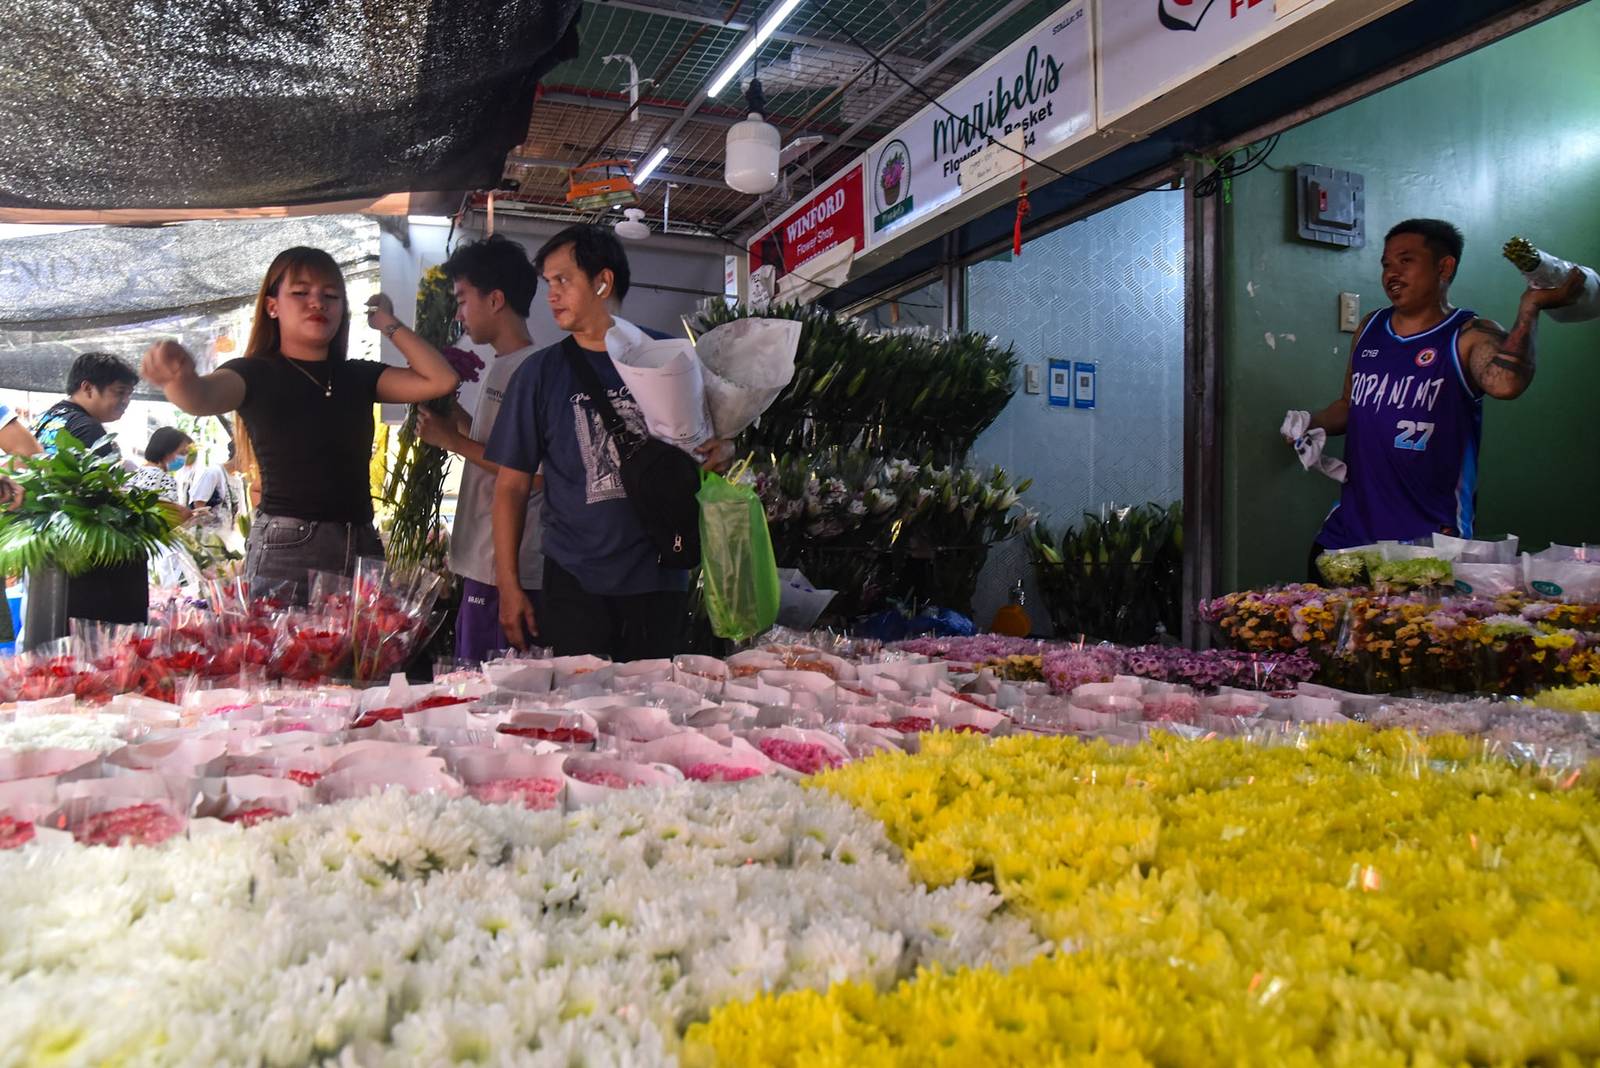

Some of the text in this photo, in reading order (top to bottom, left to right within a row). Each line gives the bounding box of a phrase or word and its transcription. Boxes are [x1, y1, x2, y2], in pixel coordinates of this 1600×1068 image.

[786, 188, 846, 244] WINFORD
[817, 226, 835, 244] Shop
[1412, 377, 1445, 412] MJ
[1393, 419, 1436, 452] 27
